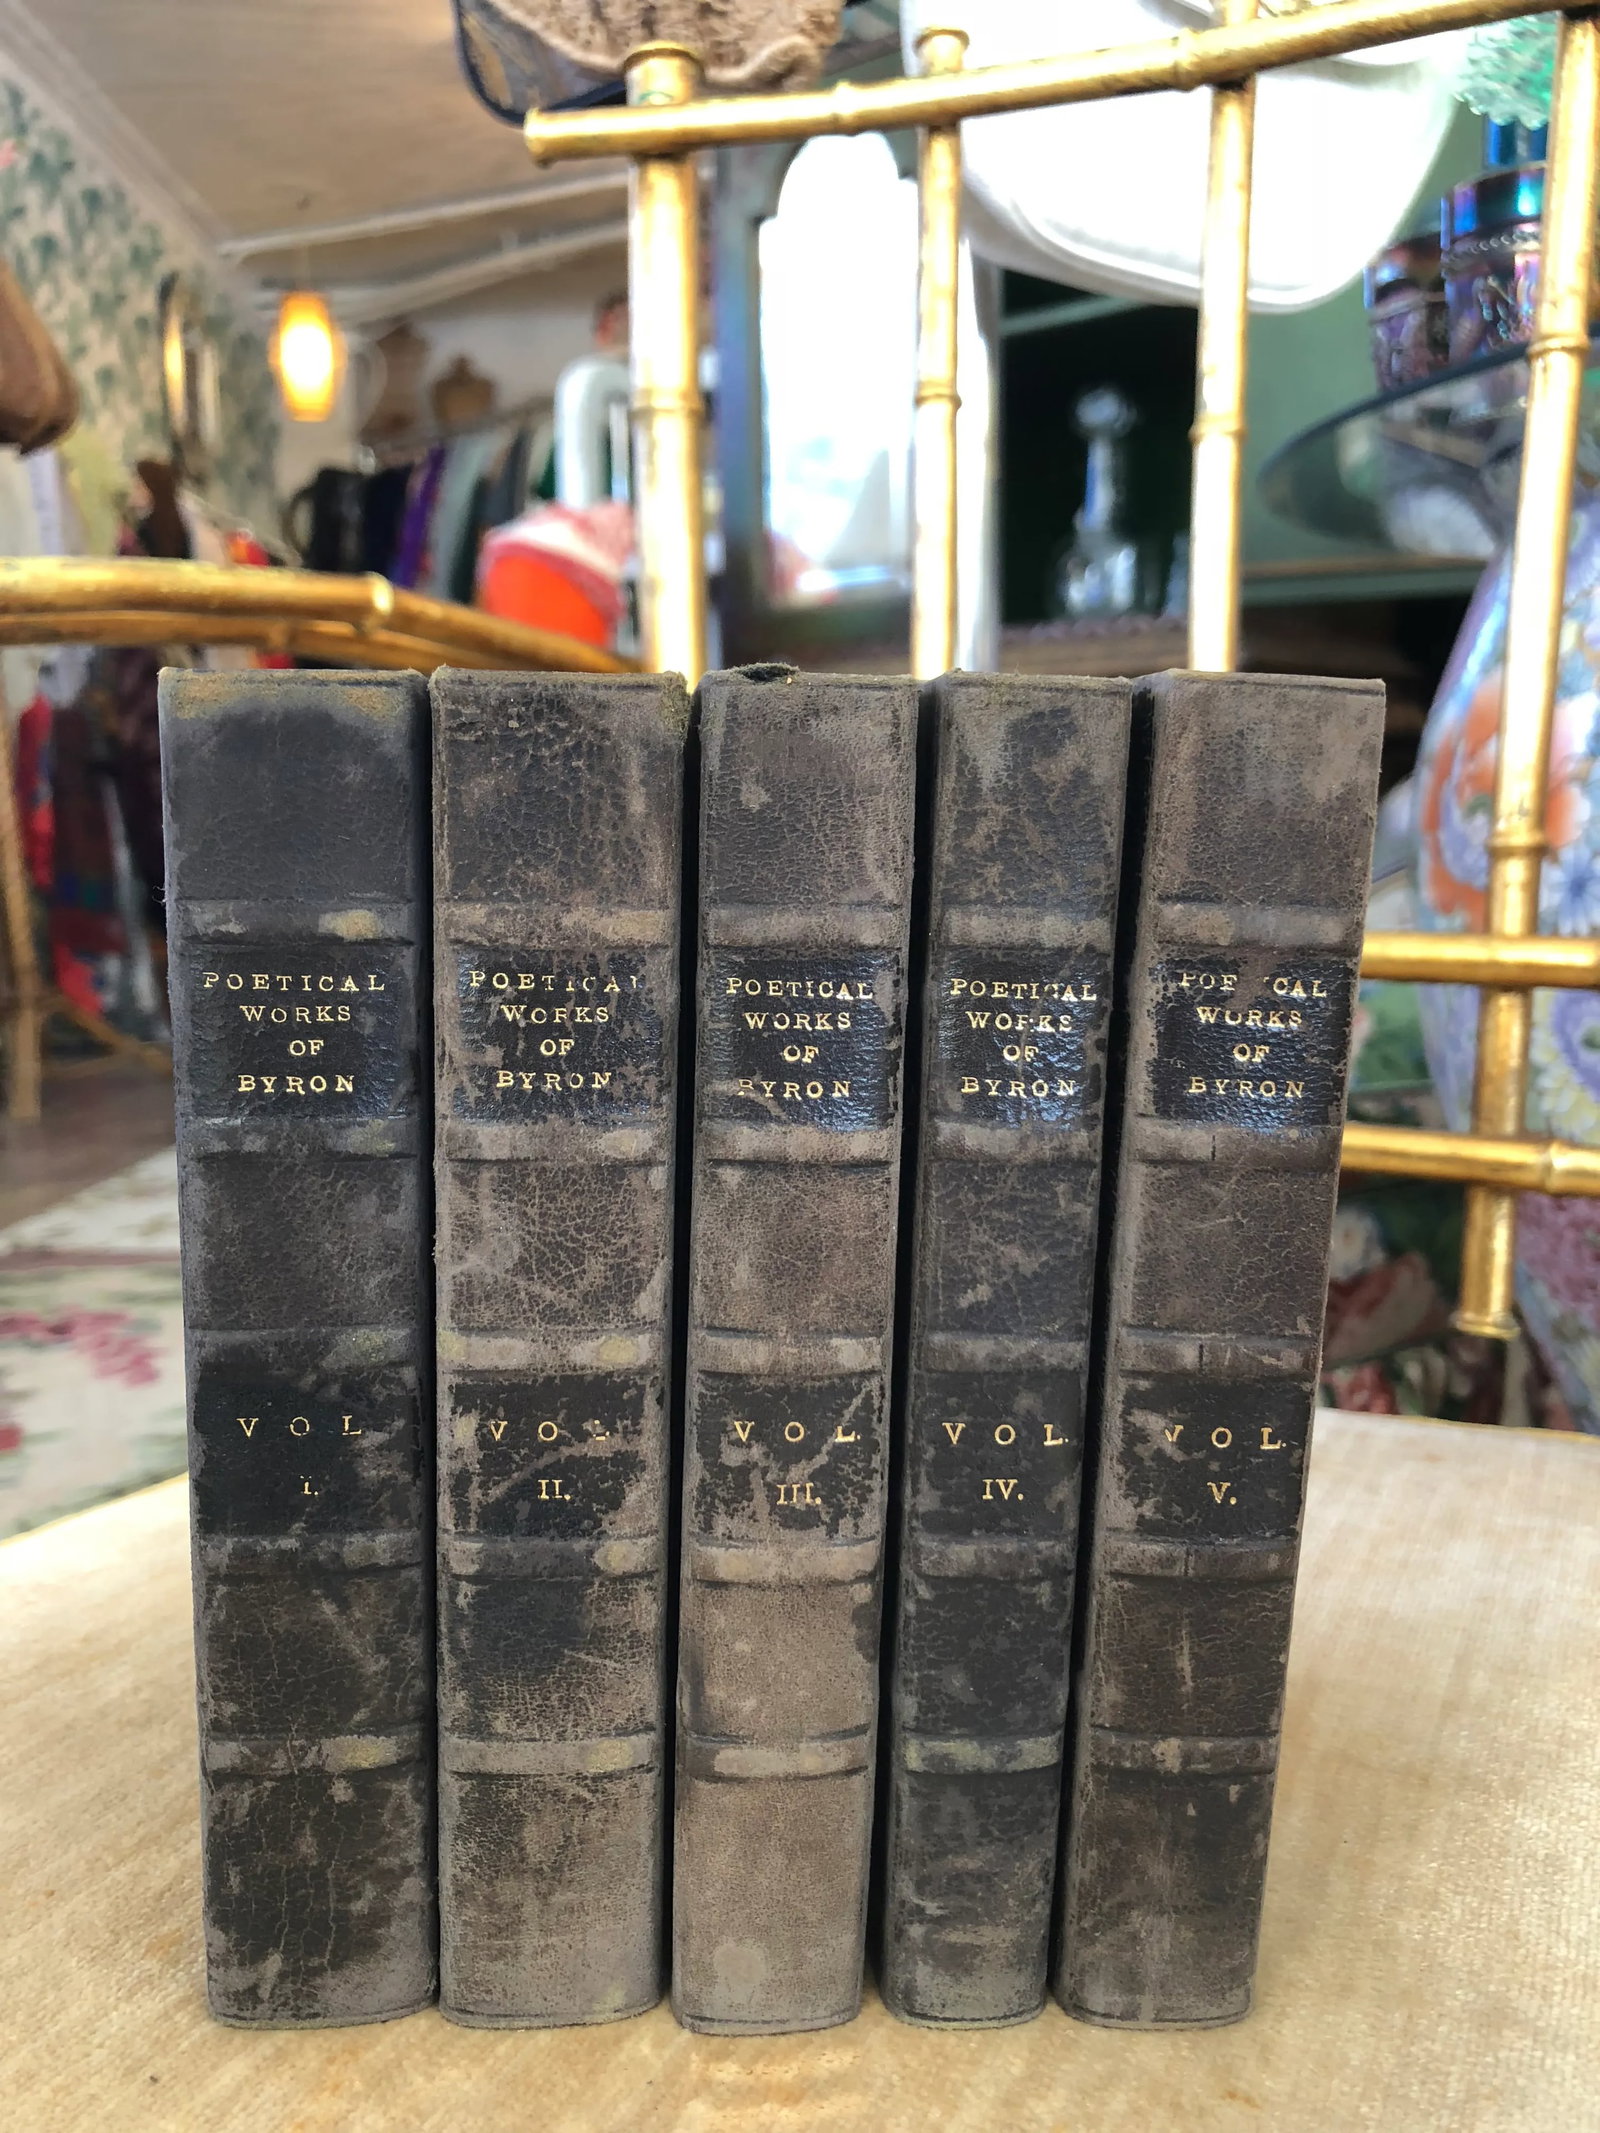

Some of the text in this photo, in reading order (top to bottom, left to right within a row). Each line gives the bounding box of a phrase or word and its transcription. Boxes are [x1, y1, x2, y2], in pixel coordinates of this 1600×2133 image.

[203, 972, 385, 992] POETICAL
[726, 977, 874, 1000] POETICAL
[950, 978, 1097, 1002] POETICAL
[1178, 972, 1328, 998] POECAL
[239, 1005, 351, 1024] WORKS
[500, 1005, 609, 1024] WORKS
[744, 1011, 851, 1031] WORKS
[965, 1011, 1072, 1032] WORKS
[1196, 1006, 1302, 1027] WORKS
[289, 1040, 325, 1056] OF
[540, 1039, 575, 1056] OF
[783, 1045, 819, 1063] OF
[1003, 1045, 1039, 1062] OF
[1233, 1043, 1270, 1063] OF
[238, 1074, 355, 1095] BYRON
[496, 1070, 612, 1091] BYRON
[961, 1076, 1077, 1098] BYRON
[1188, 1076, 1305, 1098] BYRON
[538, 1479, 571, 1500] II.
[776, 1482, 822, 1505] III.
[982, 1479, 1025, 1501] IV.
[1207, 1481, 1238, 1506] V.
